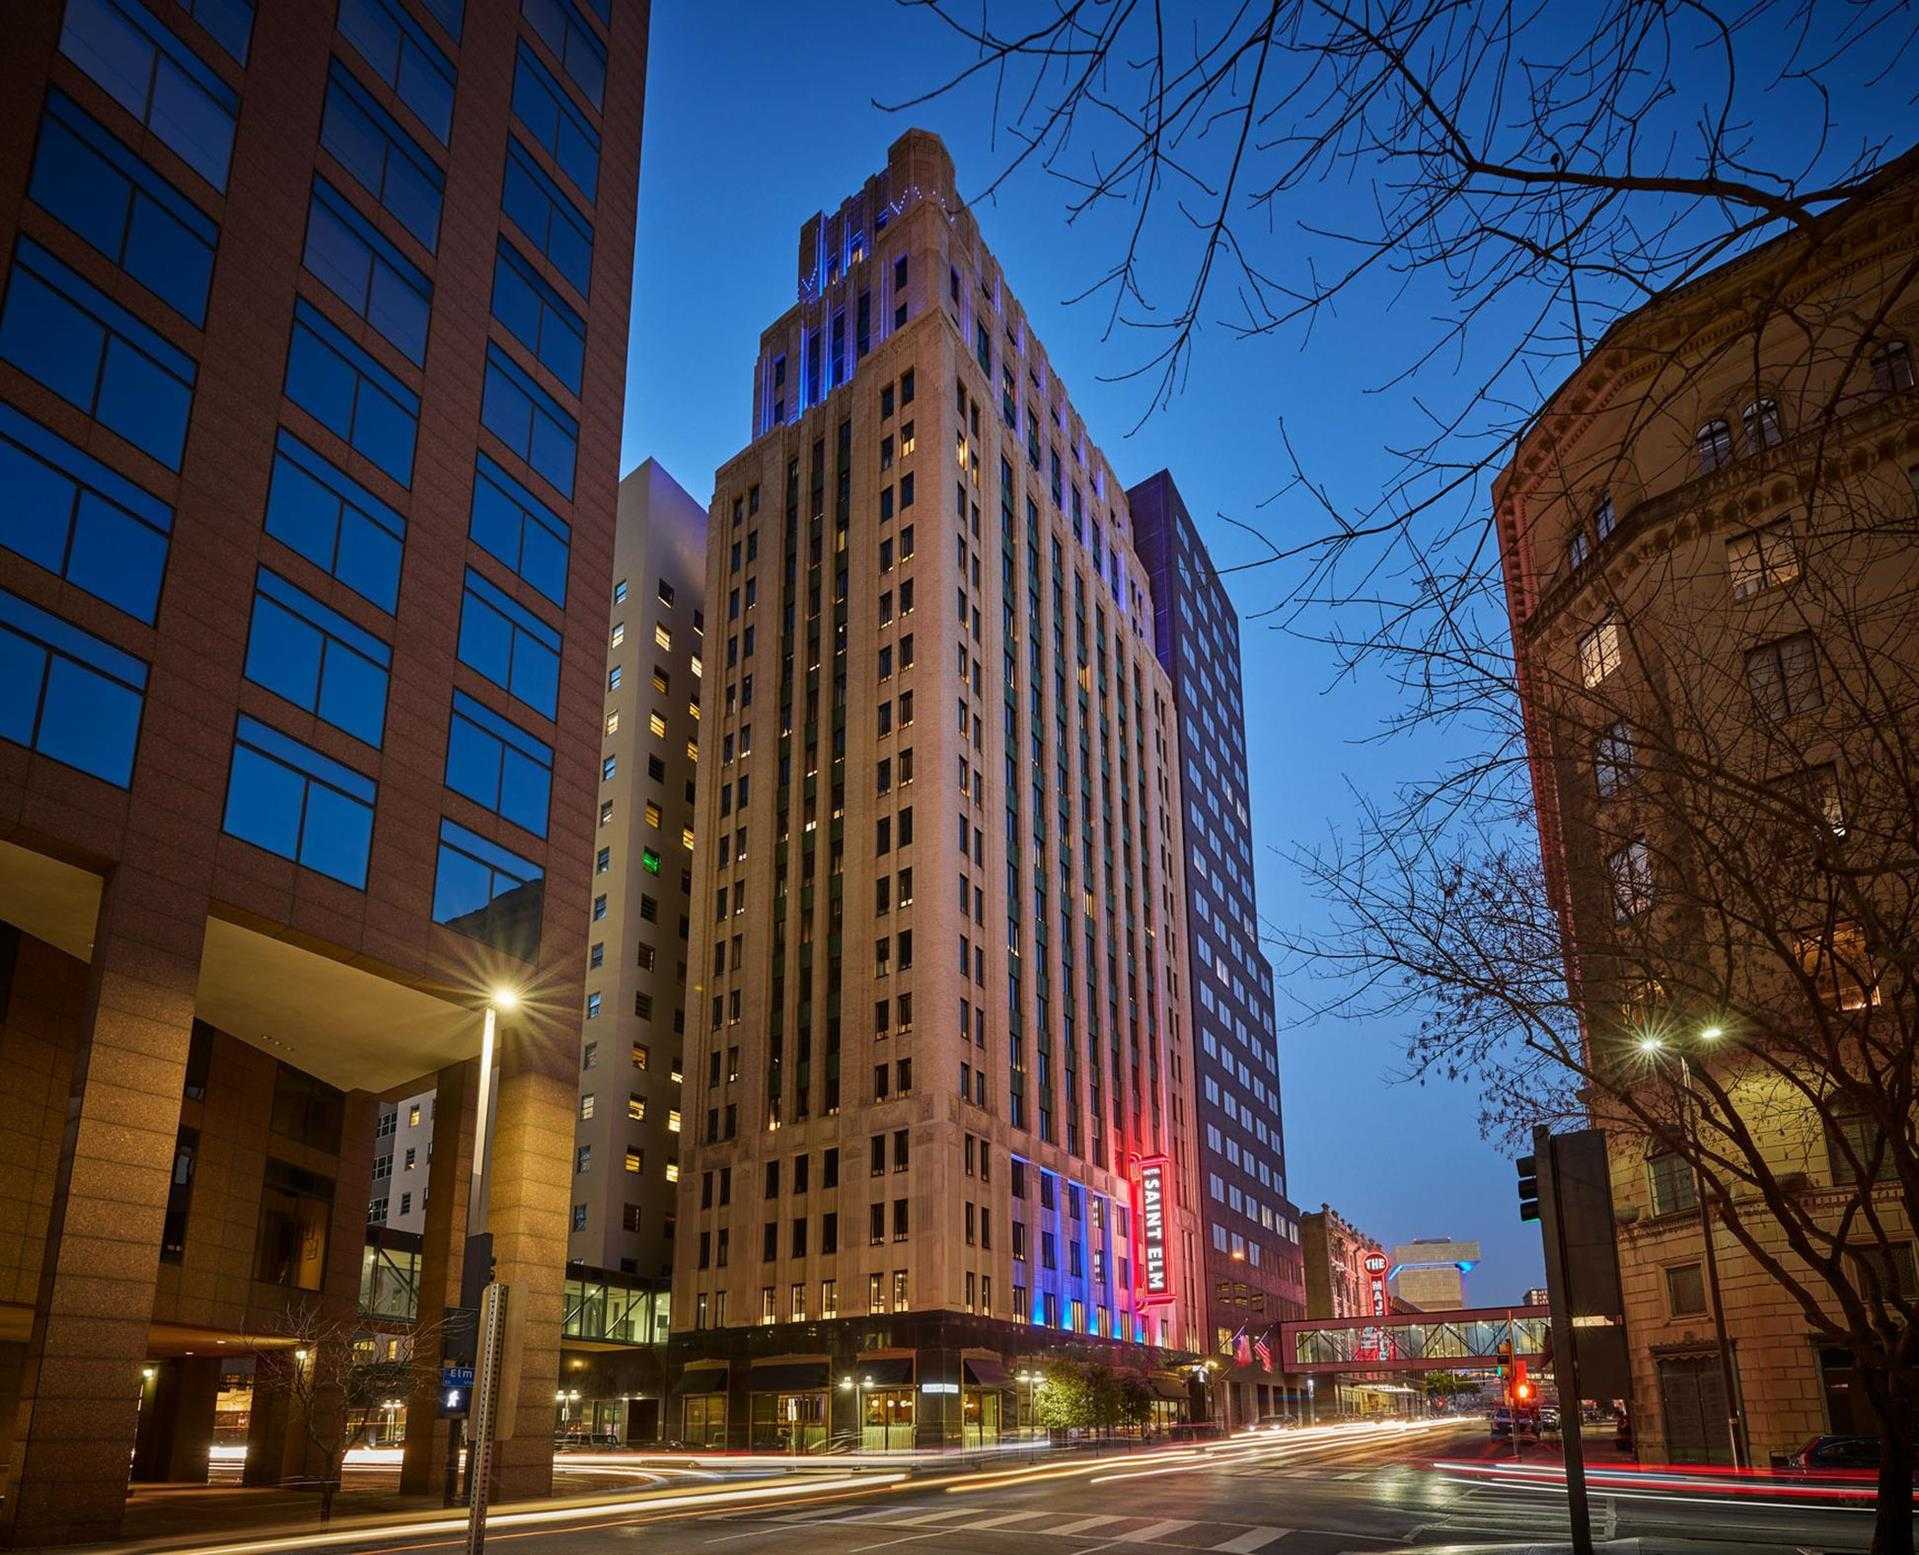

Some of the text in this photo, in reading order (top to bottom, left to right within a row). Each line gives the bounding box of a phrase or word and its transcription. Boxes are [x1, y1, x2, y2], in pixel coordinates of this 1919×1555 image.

[1144, 1179, 1162, 1239] SAINT
[1147, 1247, 1165, 1289] ELM
[1365, 1258, 1386, 1271] THE
[450, 1368, 473, 1378] Elm
